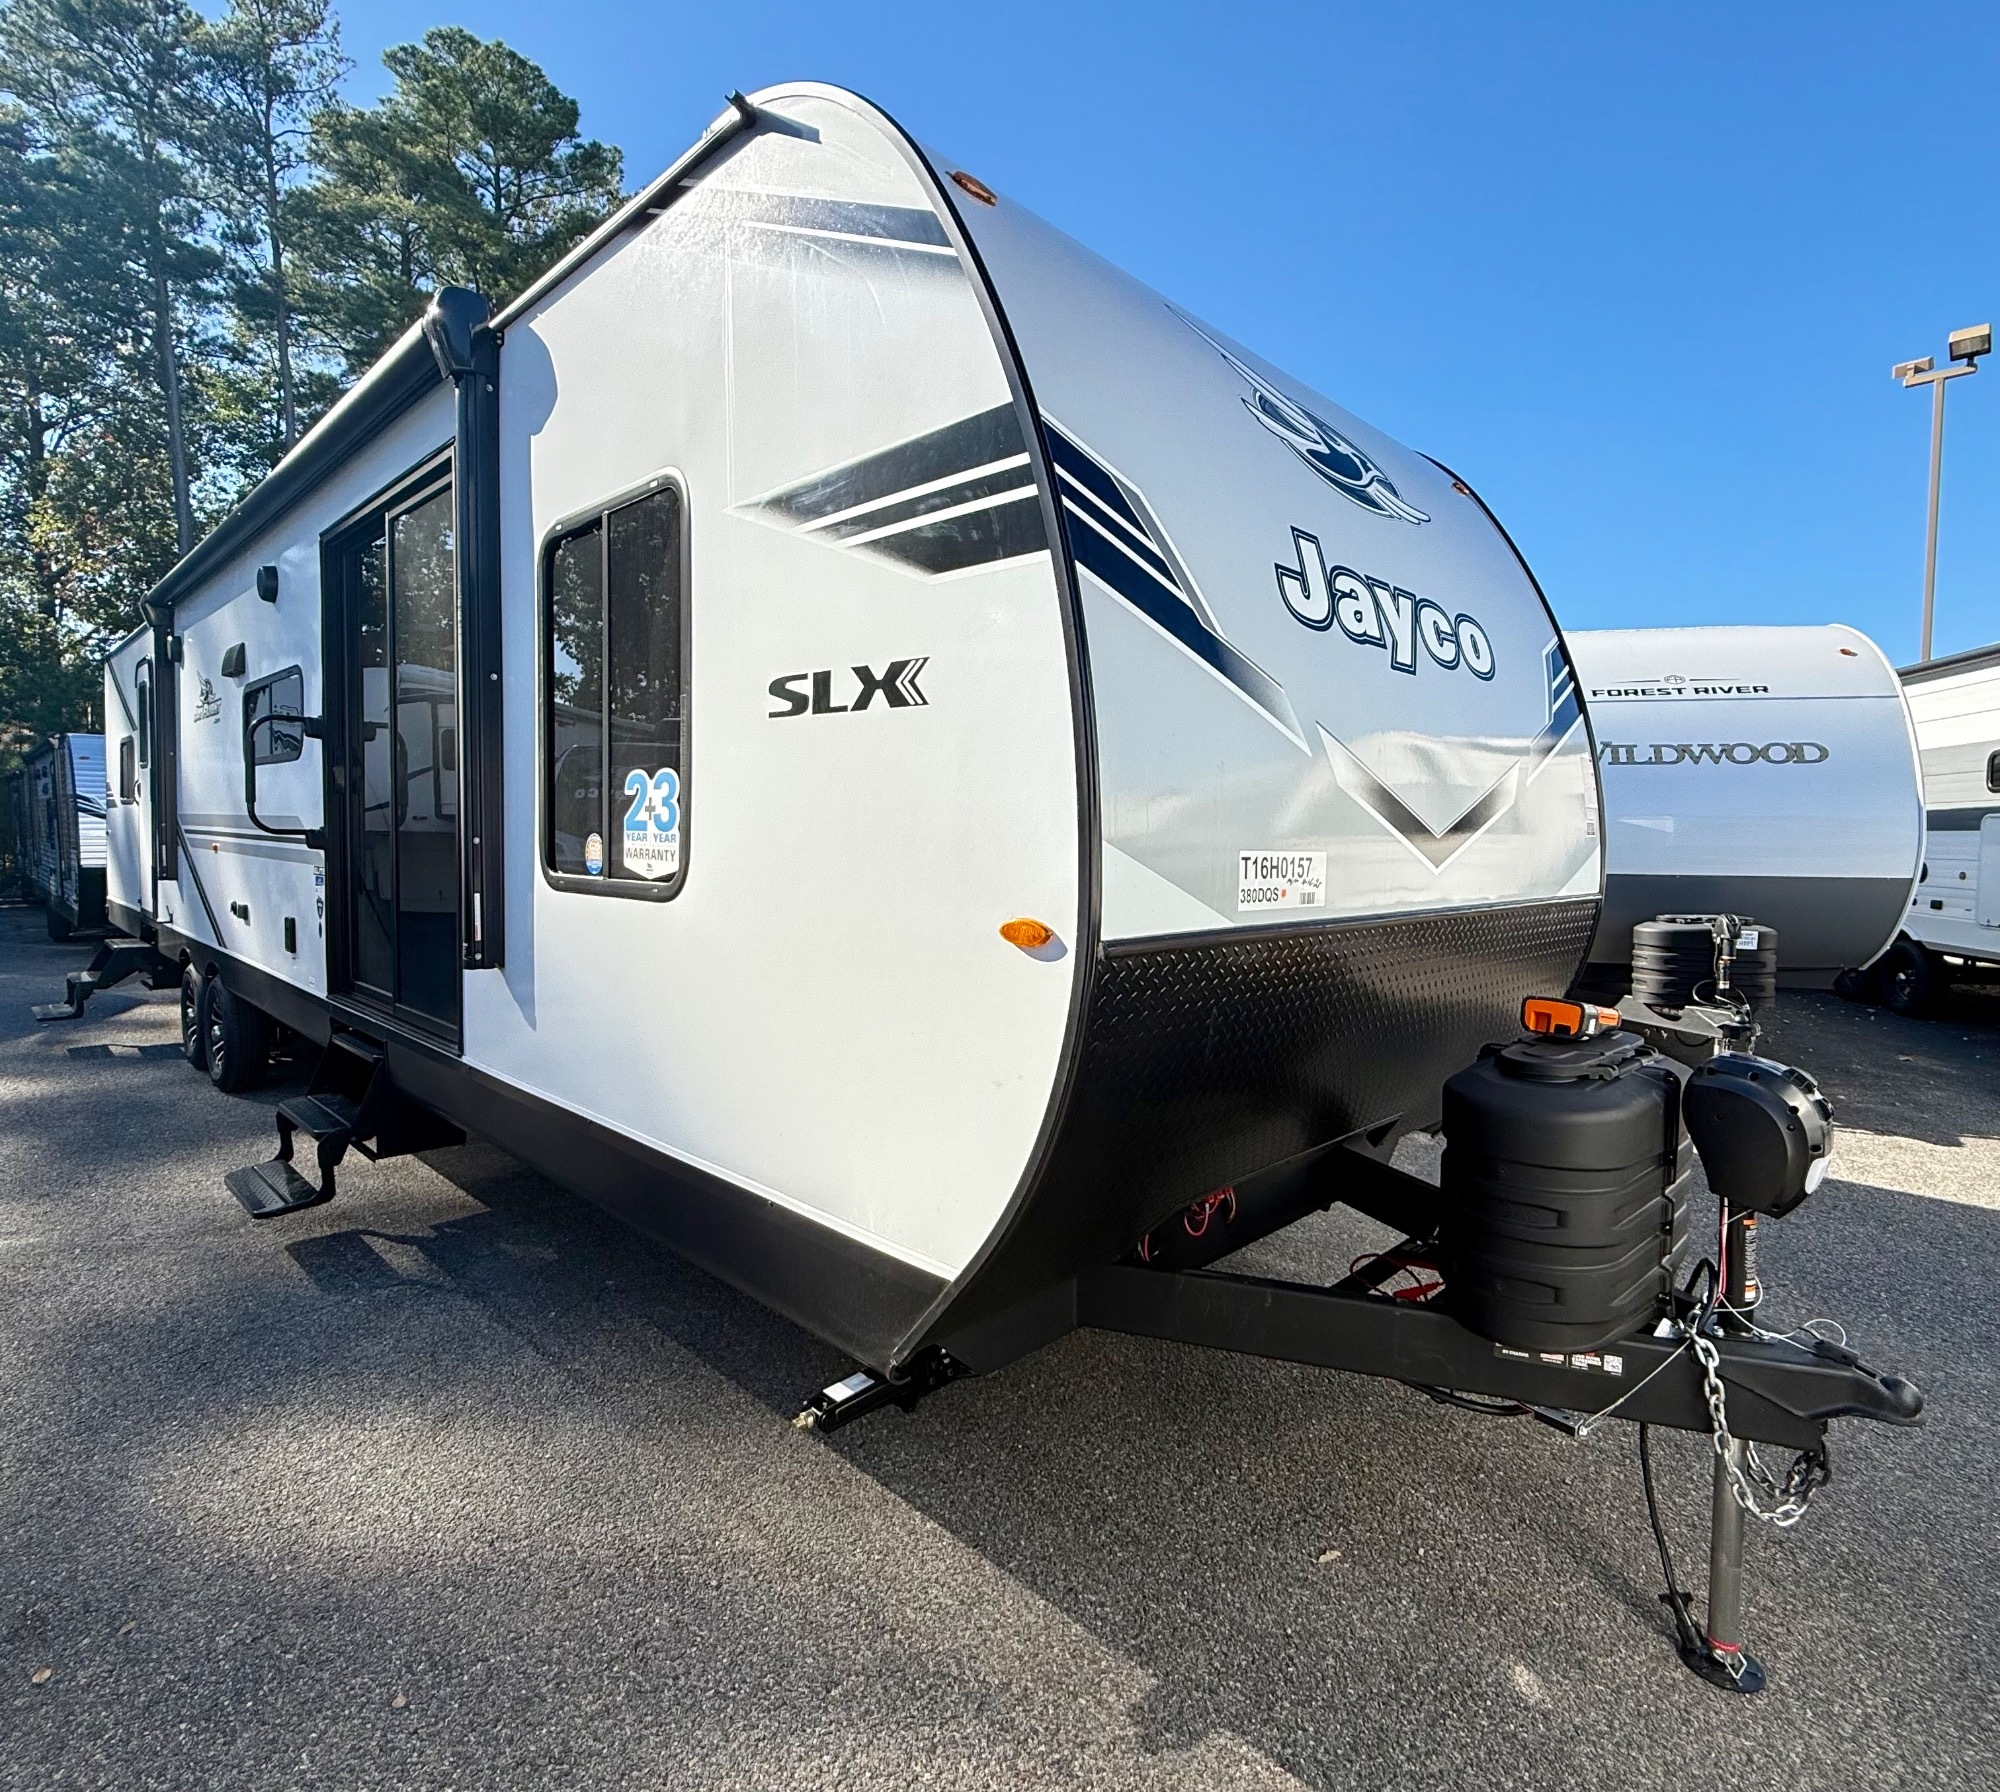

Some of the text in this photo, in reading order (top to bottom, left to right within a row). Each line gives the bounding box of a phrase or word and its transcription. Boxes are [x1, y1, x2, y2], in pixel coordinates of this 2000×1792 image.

[1274, 525, 1496, 682] Jayco
[768, 656, 931, 718] SLX
[1591, 685, 1770, 697] FOREST RIVER
[1598, 741, 1830, 766] ILDWOOD
[625, 832, 677, 844] YEAR YEAR
[625, 847, 677, 863] WARRANTY
[1241, 856, 1313, 880] T16H0157
[1240, 887, 1280, 904] 380DQS
